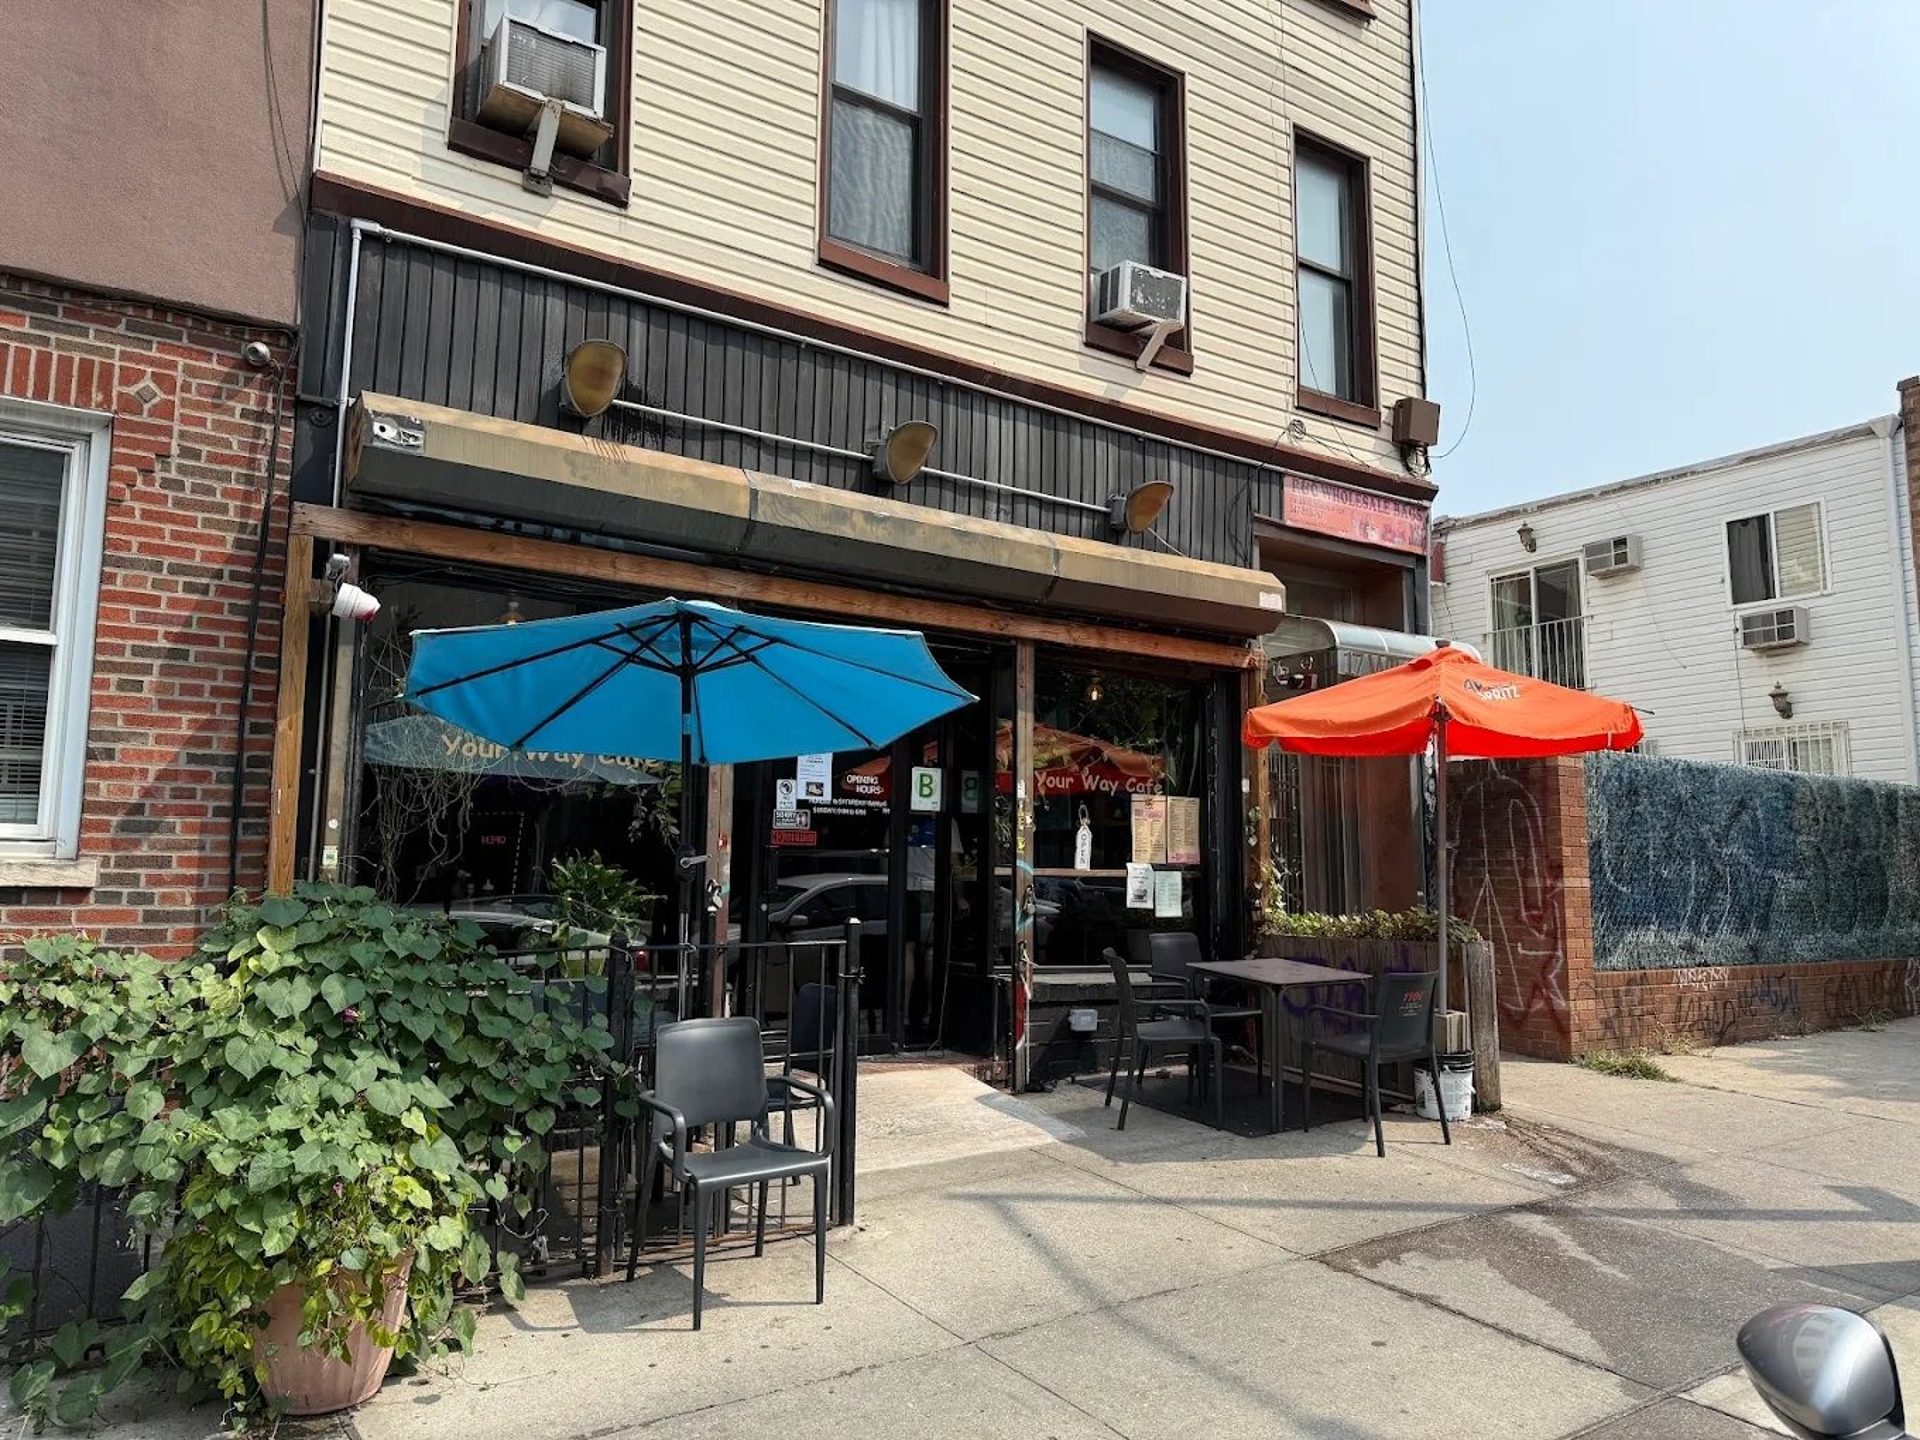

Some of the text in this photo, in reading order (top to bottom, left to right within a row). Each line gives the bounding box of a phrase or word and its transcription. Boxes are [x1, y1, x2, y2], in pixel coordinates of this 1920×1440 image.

[1320, 483, 1391, 515] WHOLESALE
[1393, 502, 1424, 522] BAGS
[441, 733, 508, 758] Your
[846, 774, 879, 785] OPENING
[919, 773, 934, 798] B
[1034, 770, 1074, 789] Your
[1081, 774, 1119, 796] Way
